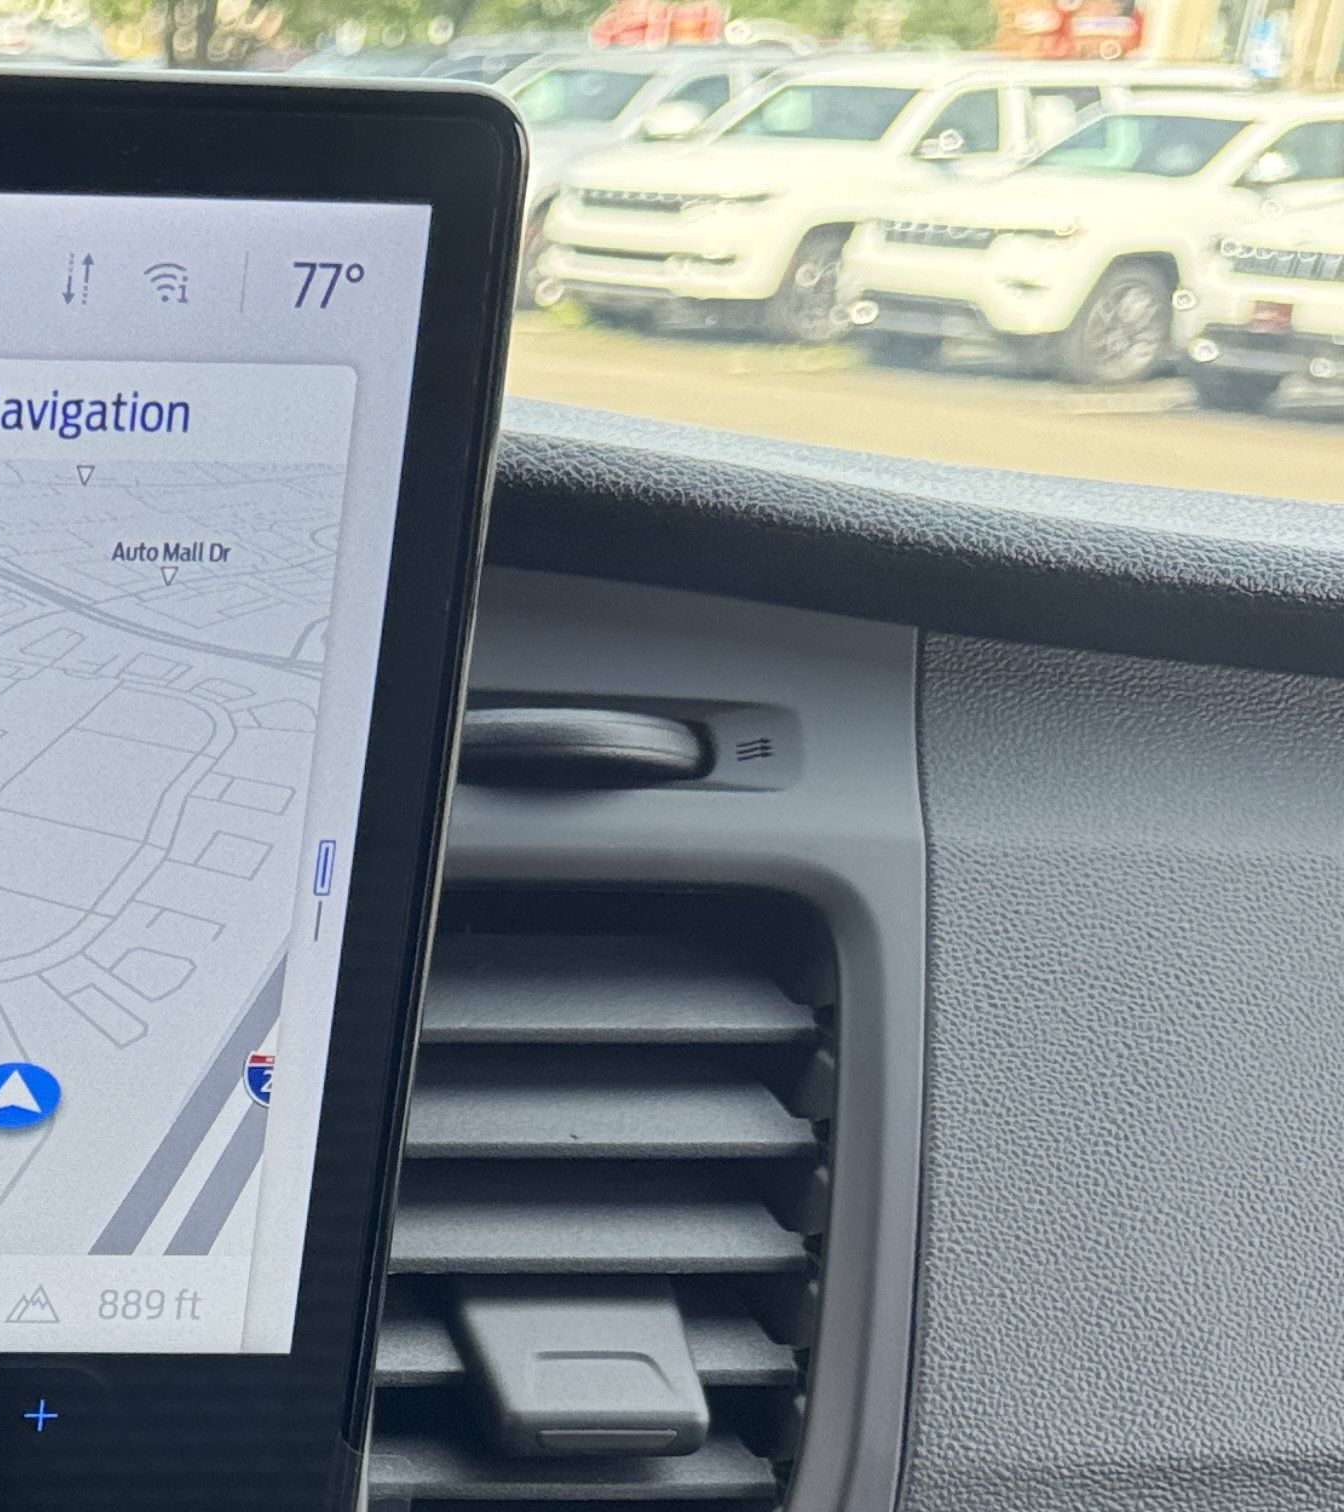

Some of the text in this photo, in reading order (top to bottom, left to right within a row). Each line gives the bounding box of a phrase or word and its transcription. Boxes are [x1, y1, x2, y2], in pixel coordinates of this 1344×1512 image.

[292, 261, 366, 309] 77°
[111, 542, 231, 562] Auto Mall Dr
[97, 1288, 202, 1321] 889 ft
